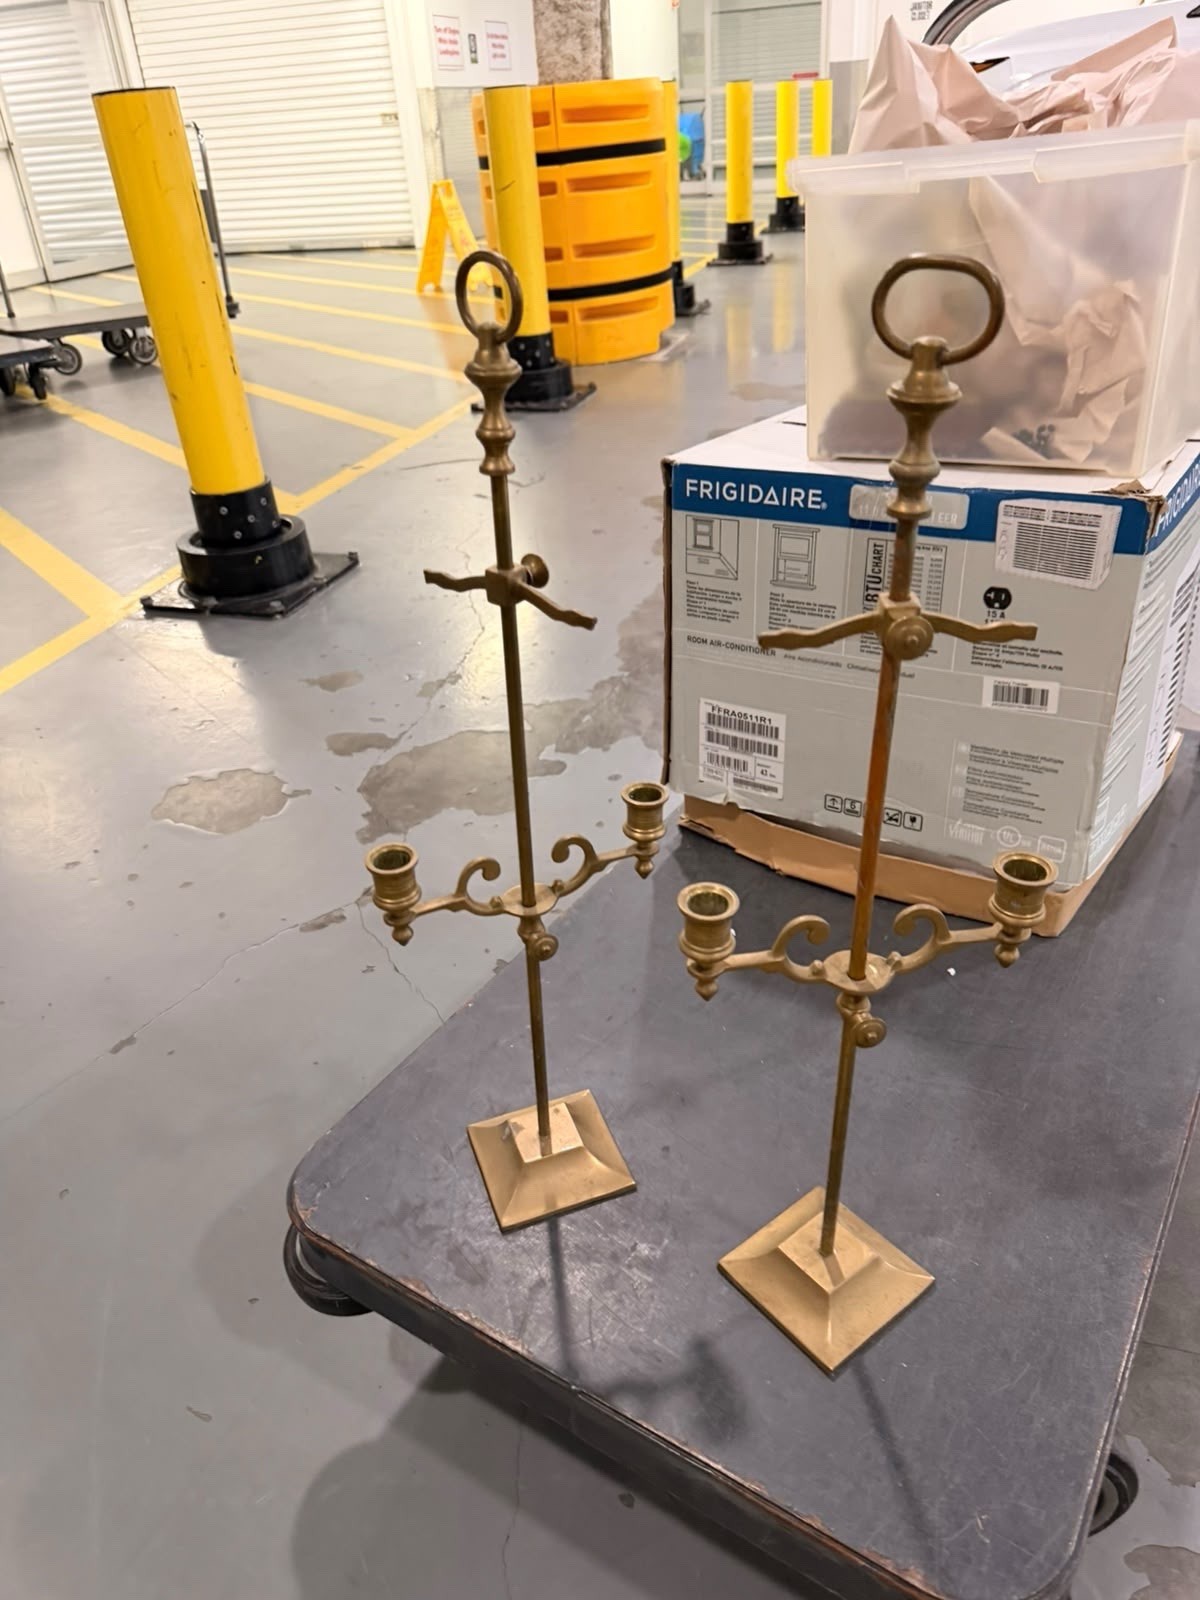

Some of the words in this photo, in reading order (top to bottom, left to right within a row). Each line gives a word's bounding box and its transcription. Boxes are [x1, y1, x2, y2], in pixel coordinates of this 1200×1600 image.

[686, 478, 823, 510] FRIGIDAIRE
[872, 543, 885, 575] CHART
[987, 610, 998, 618] 15
[999, 611, 1006, 620] A
[687, 634, 708, 646] ROOM
